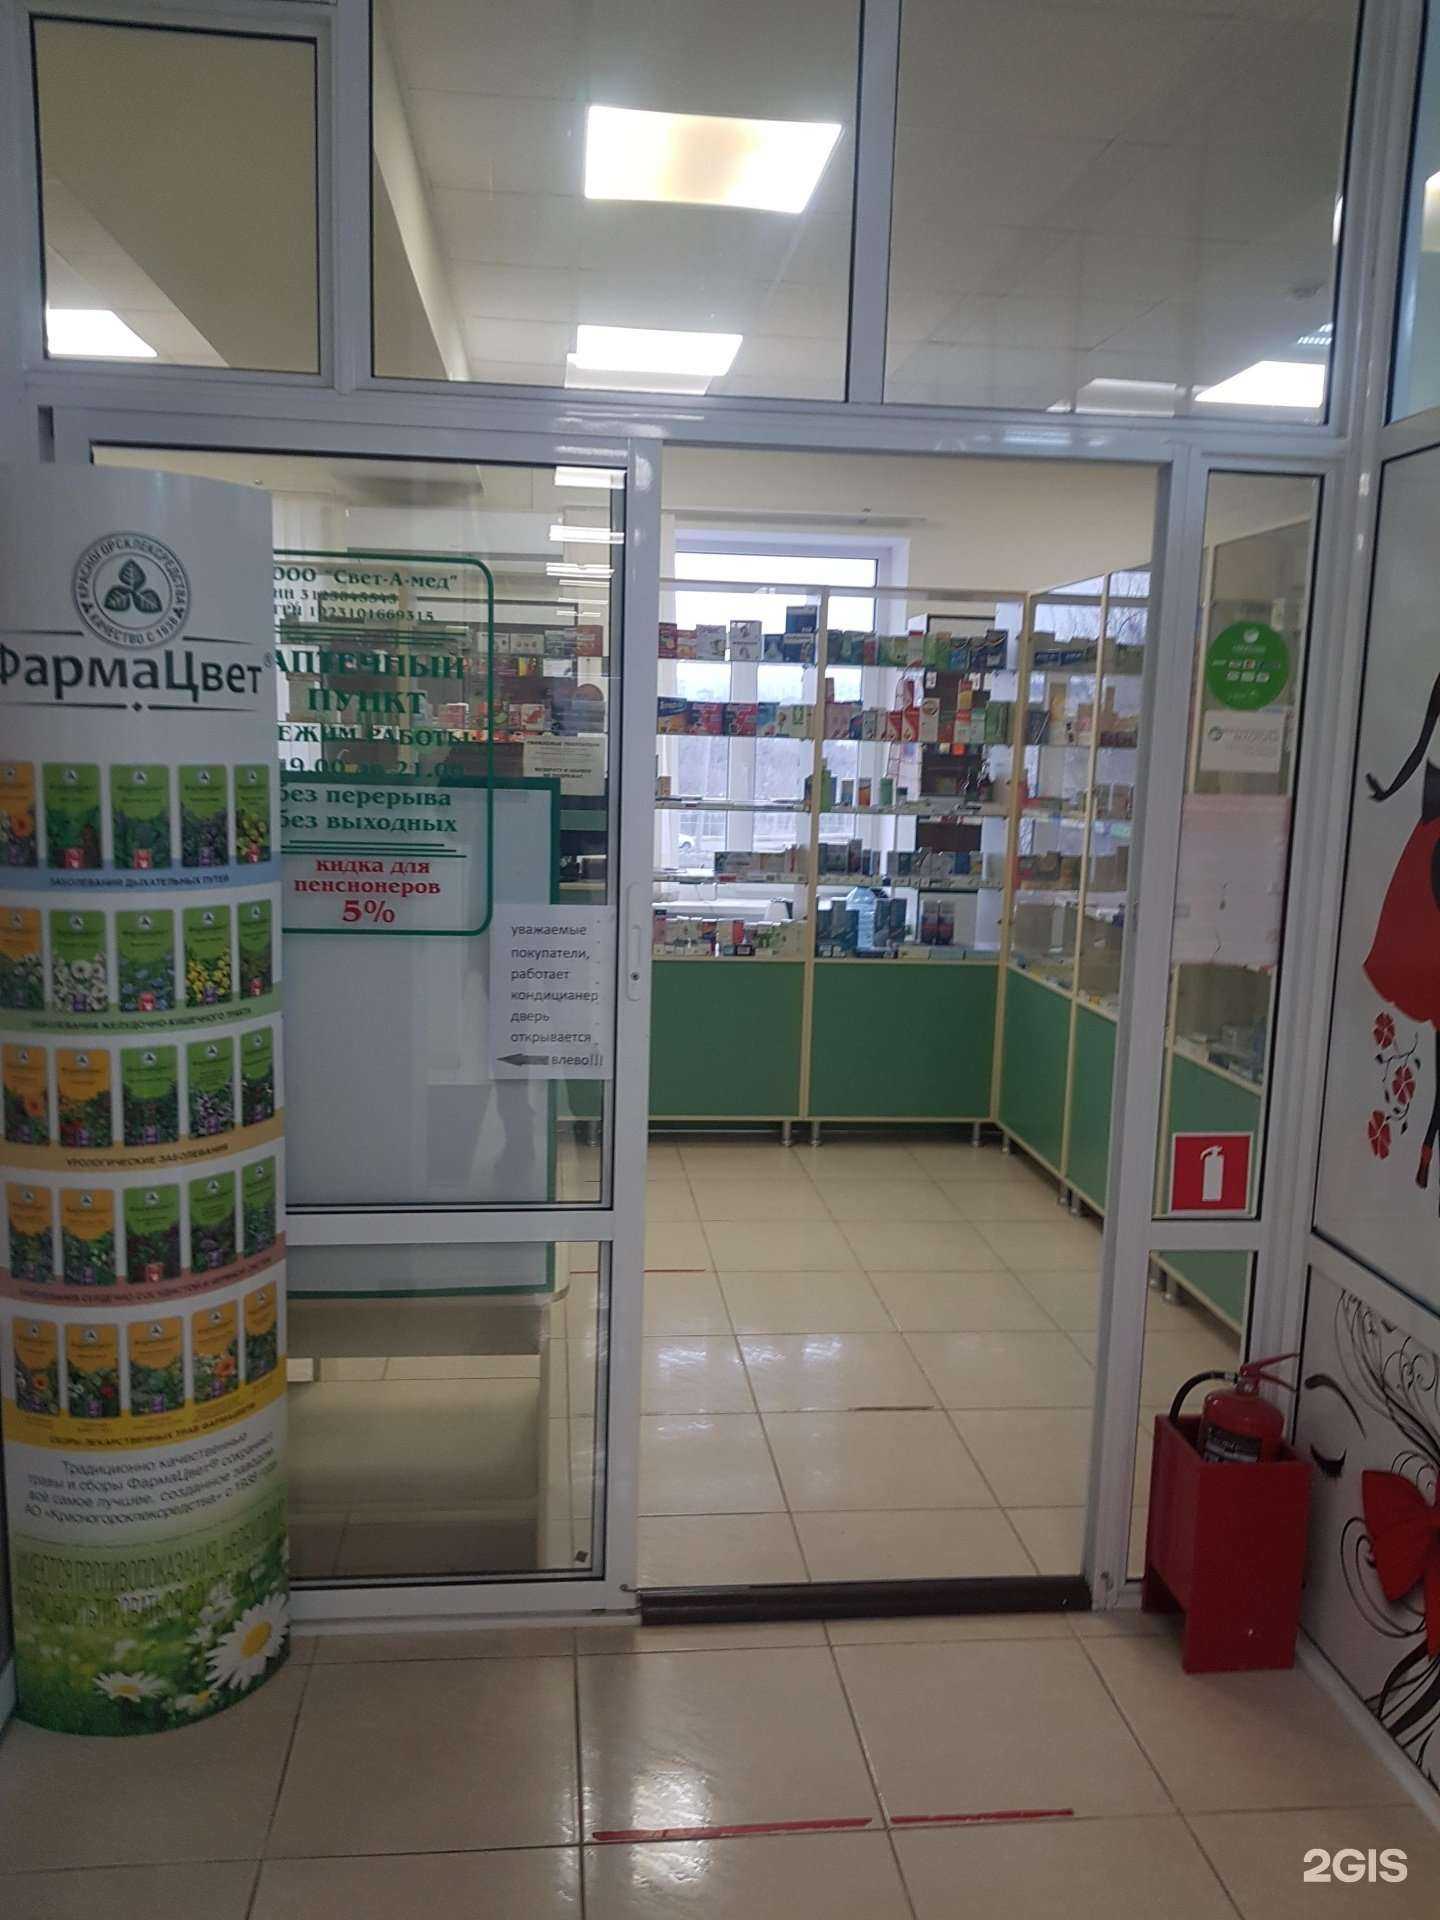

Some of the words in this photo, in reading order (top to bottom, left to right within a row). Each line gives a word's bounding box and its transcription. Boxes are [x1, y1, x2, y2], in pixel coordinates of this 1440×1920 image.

[308, 688, 427, 714] ПУНКТ
[326, 788, 451, 809] перерыва
[327, 815, 458, 833] выходных
[390, 861, 430, 875] для
[294, 879, 441, 898] пенсионеров
[342, 900, 396, 924] 5%
[511, 925, 588, 936] уважаемые
[511, 948, 591, 960] покупатели,
[511, 968, 570, 981] работает
[510, 1012, 550, 1024] дверь
[510, 1033, 592, 1045] открывается
